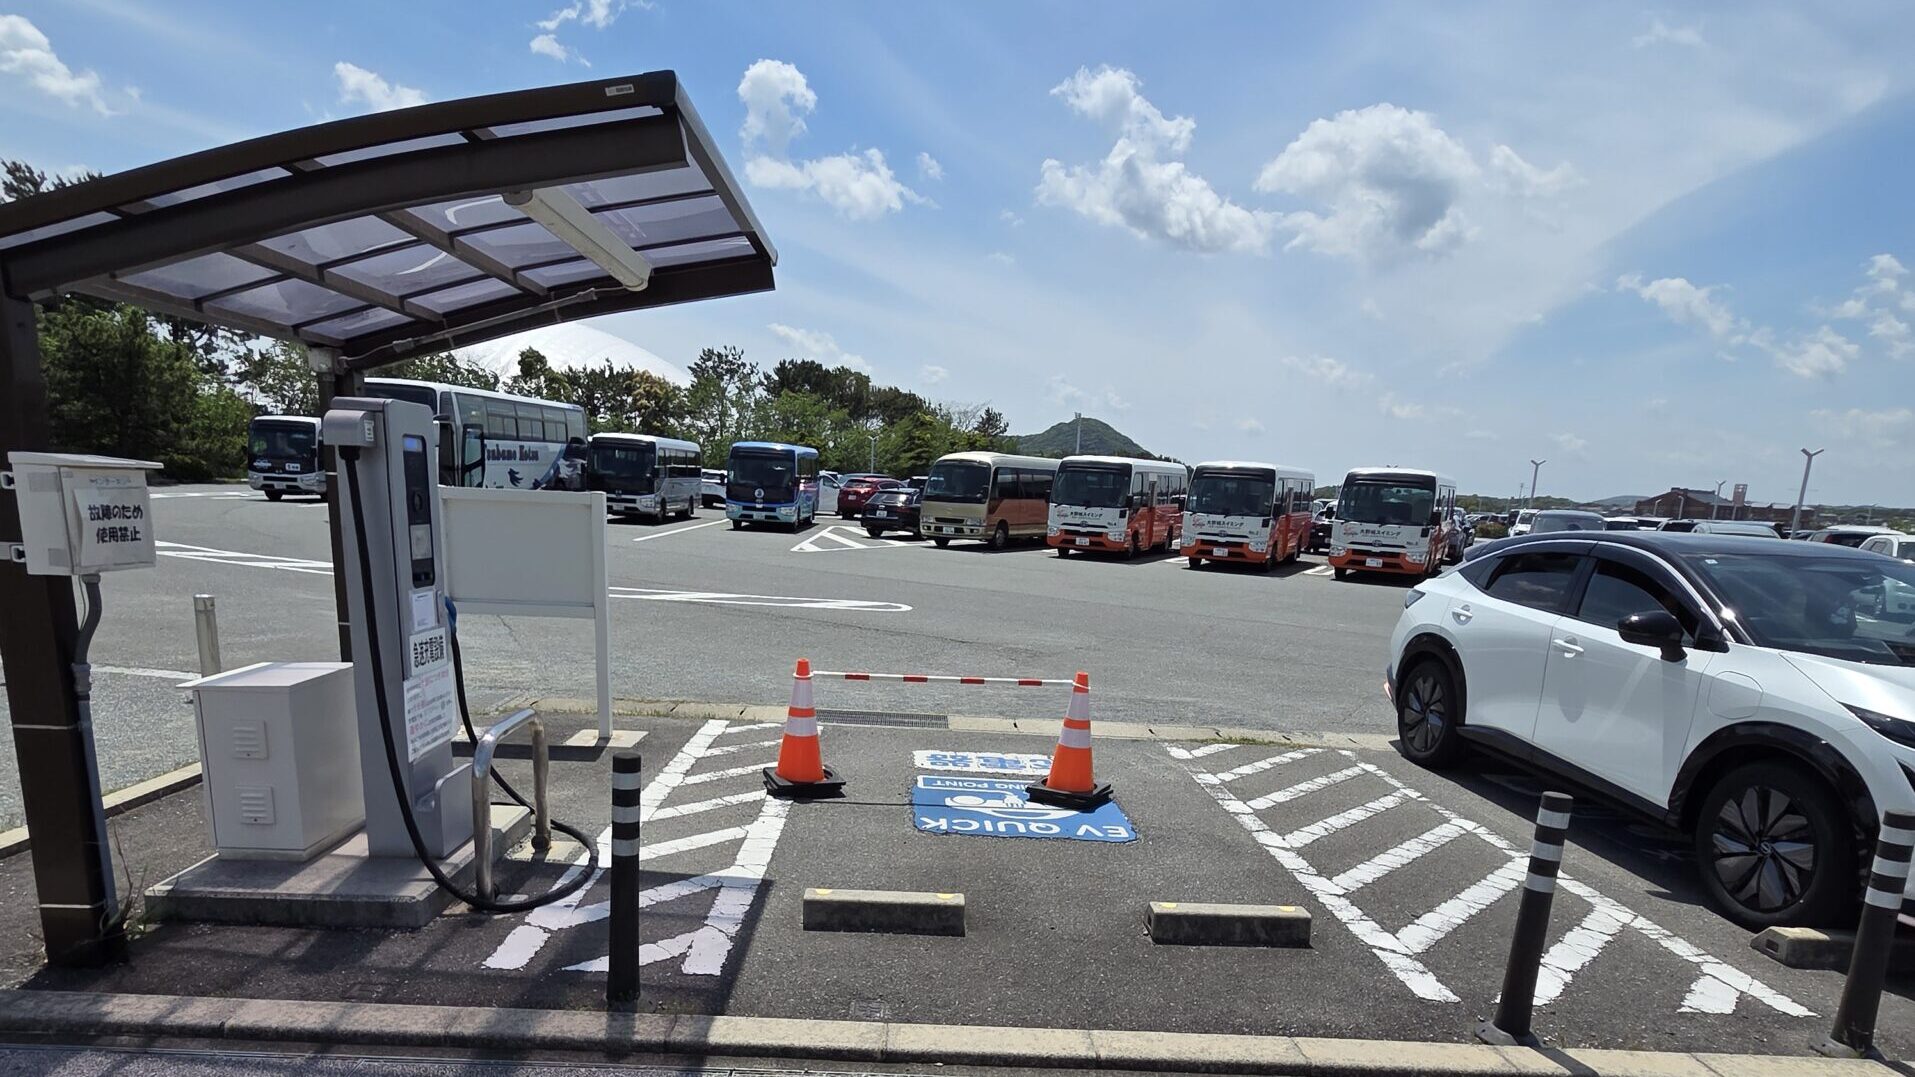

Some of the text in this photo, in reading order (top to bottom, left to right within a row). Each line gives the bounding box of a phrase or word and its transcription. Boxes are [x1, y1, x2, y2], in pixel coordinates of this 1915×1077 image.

[88, 504, 143, 521] 故障のため
[96, 526, 142, 544] 使用禁止
[932, 780, 989, 788] POINT
[920, 817, 1129, 838] EV QUICK
